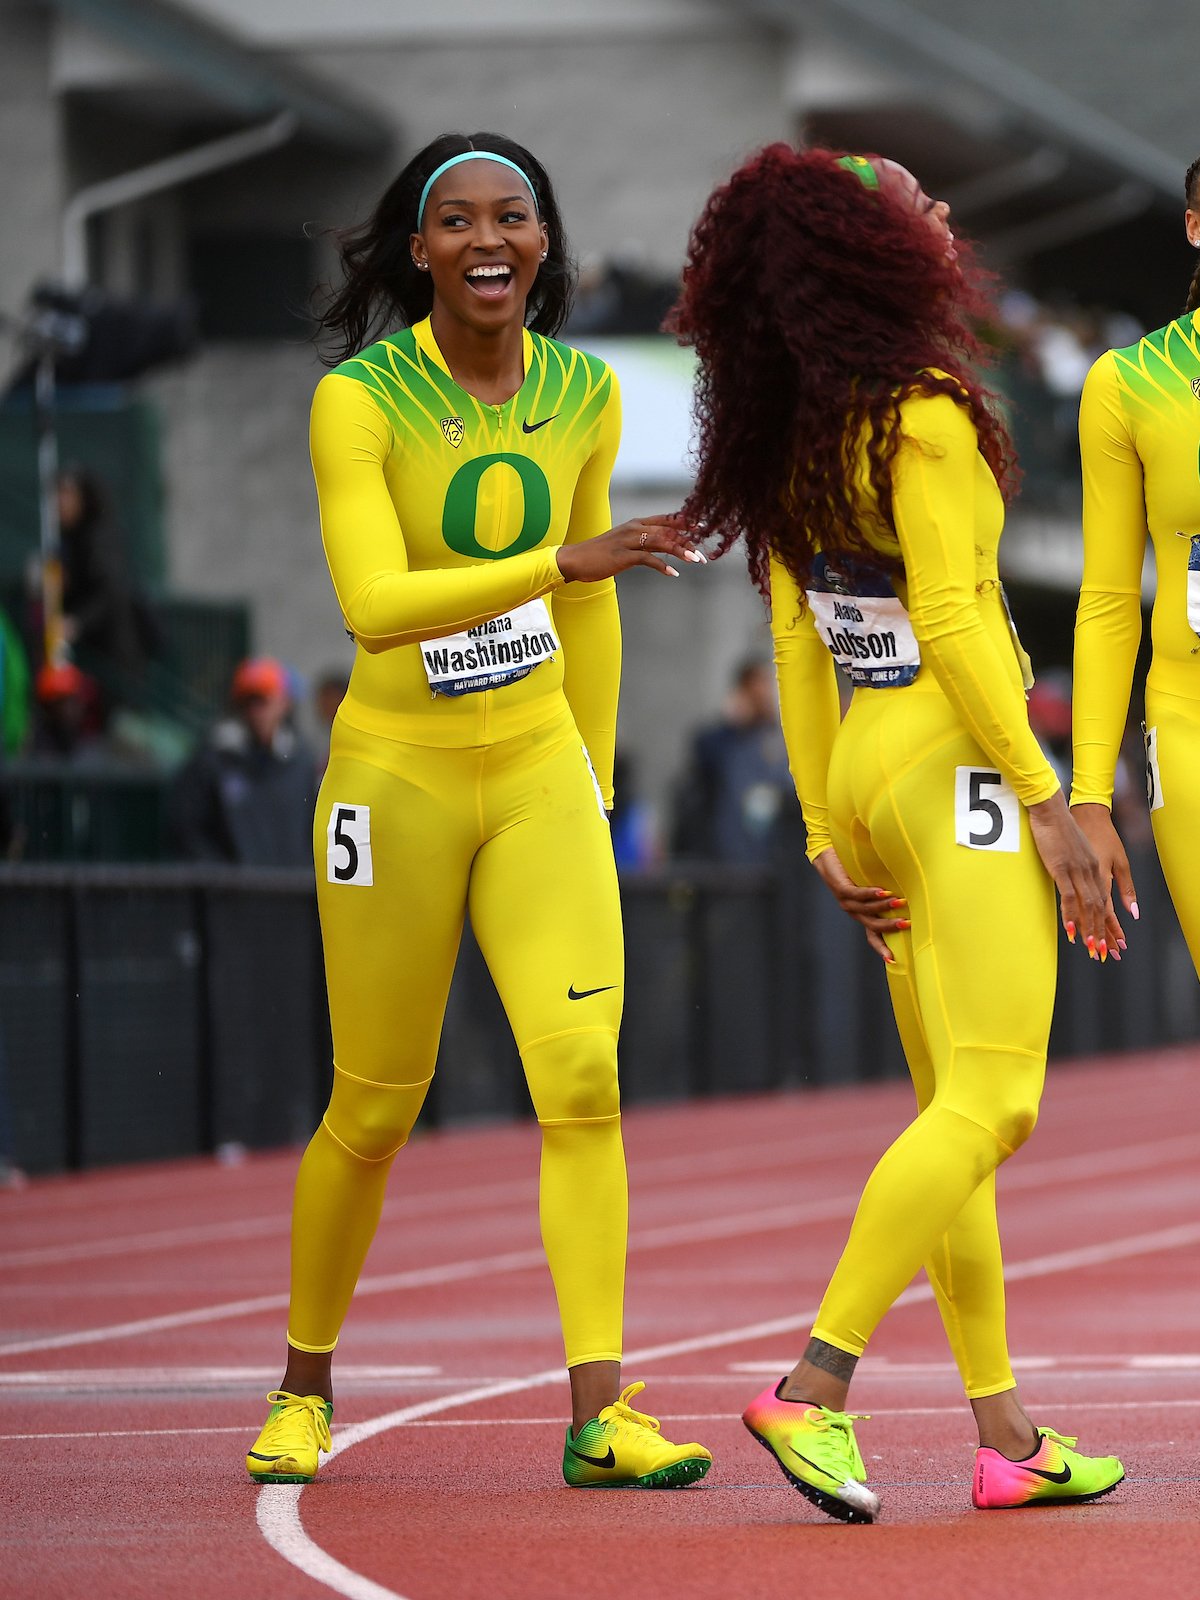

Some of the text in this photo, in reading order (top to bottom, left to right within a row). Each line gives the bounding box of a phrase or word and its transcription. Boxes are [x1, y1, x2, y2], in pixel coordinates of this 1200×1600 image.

[442, 418, 463, 436] PAC
[449, 431, 460, 441] 12
[441, 452, 552, 561] O
[424, 631, 557, 675] Washington
[454, 677, 488, 690] HAYWARD
[488, 673, 506, 684] FIELD
[871, 671, 888, 681] JUNE
[969, 771, 1003, 846] 5
[334, 808, 359, 881] 5
